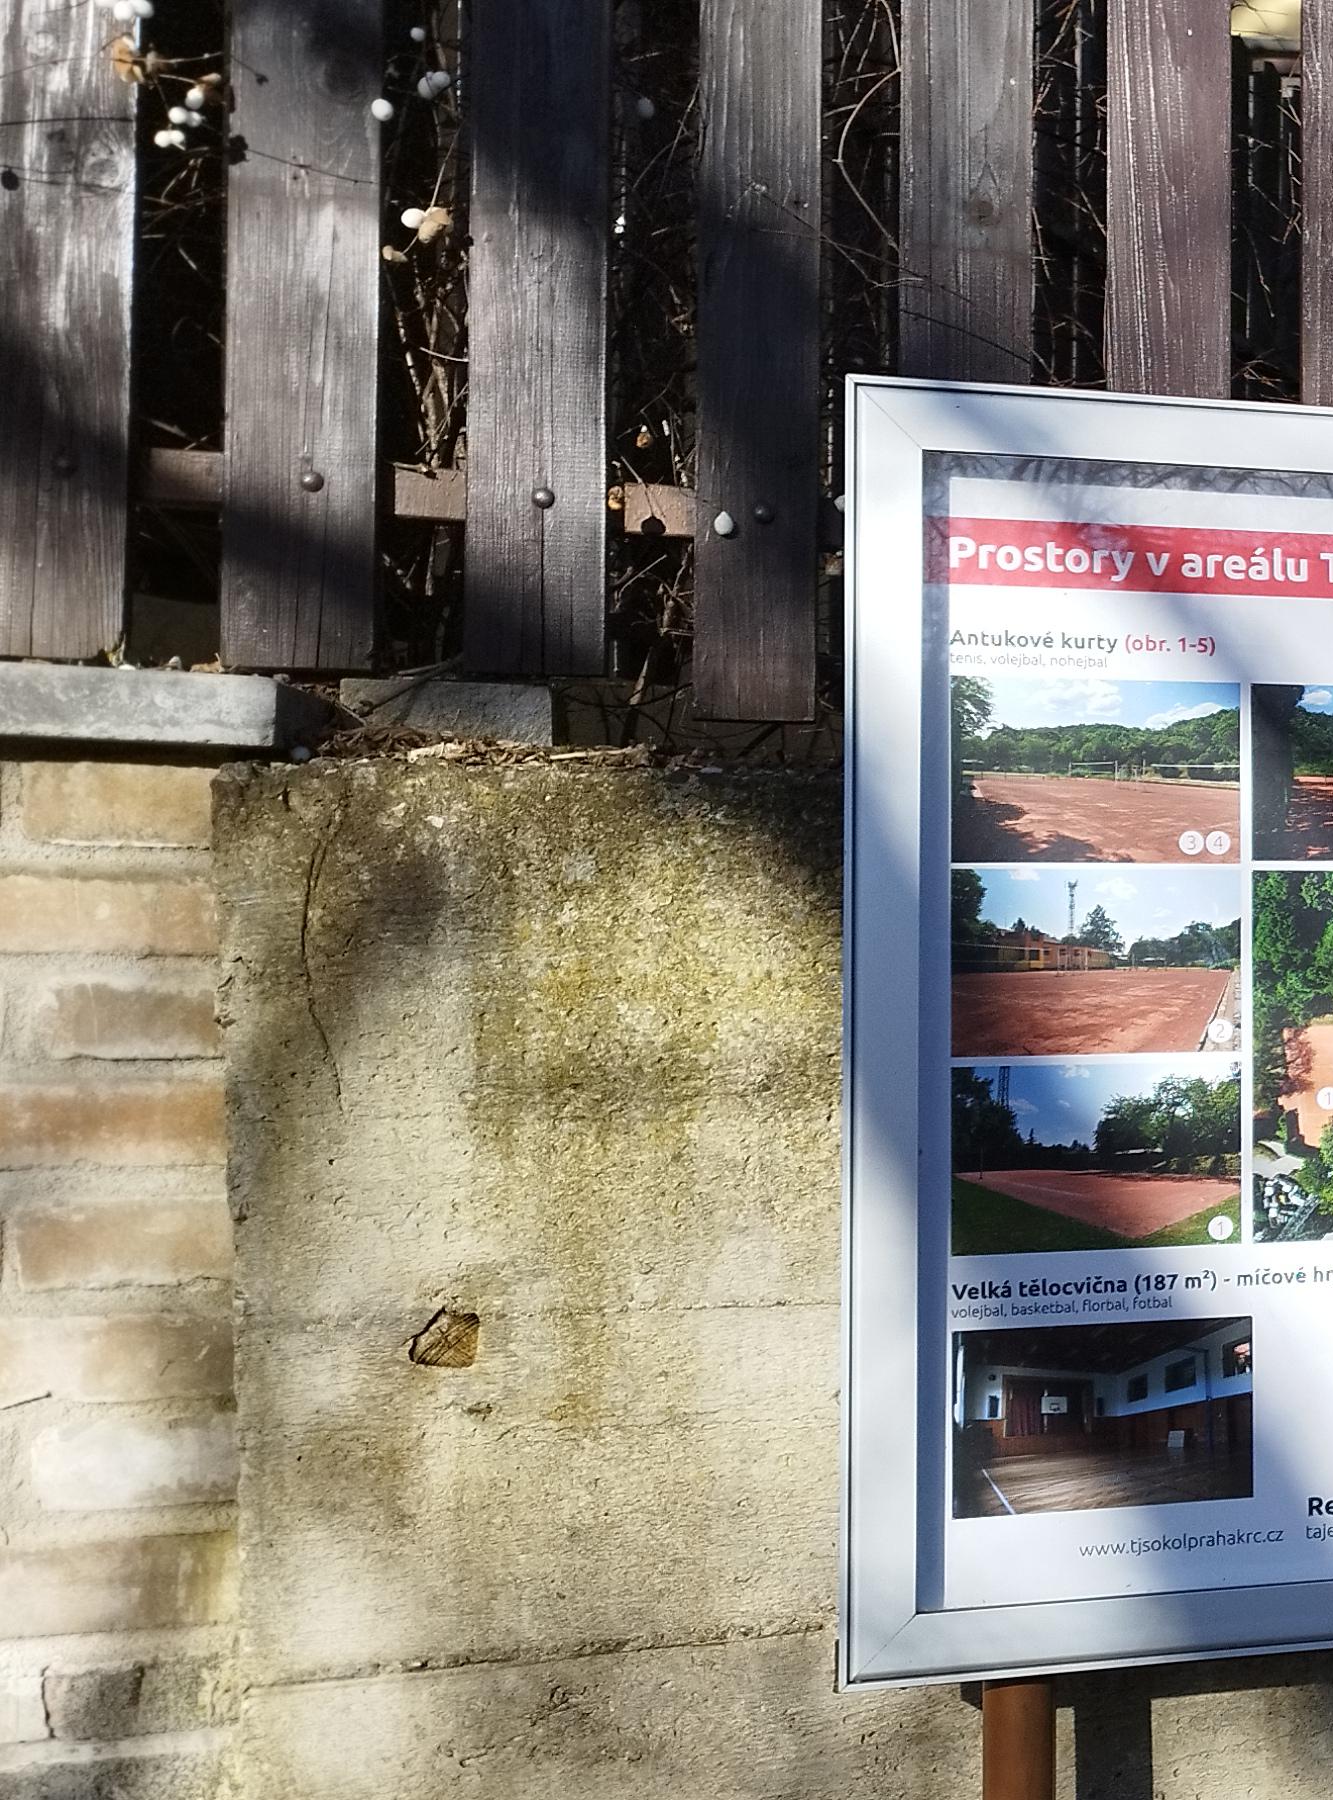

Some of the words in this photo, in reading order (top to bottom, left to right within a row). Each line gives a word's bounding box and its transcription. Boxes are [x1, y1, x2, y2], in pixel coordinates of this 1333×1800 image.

[950, 537, 1134, 582] Prostory
[1147, 552, 1170, 576] v
[1181, 547, 1308, 582] areálu
[950, 630, 1054, 650] Antukové
[1061, 632, 1118, 654] kurty
[1125, 632, 1171, 653] (obr.
[1178, 635, 1215, 657] 1-5)
[950, 653, 986, 666] tenis,
[991, 652, 1045, 669] volejbal,
[1050, 655, 1107, 669] nohejbal
[1187, 834, 1197, 850] 3
[1213, 835, 1223, 850] 4
[1215, 1022, 1227, 1039] 2
[952, 1279, 1012, 1301] Velká
[1019, 1273, 1127, 1298] tělocvična
[1135, 1272, 1176, 1296] (187
[1237, 1266, 1306, 1287] míčové
[951, 1302, 1008, 1320] volejbal,
[1012, 1299, 1078, 1316] basketbal,
[1133, 1295, 1172, 1312] fotbal
[1080, 1529, 1284, 1557] www.tjsokolprahakrc.cz
